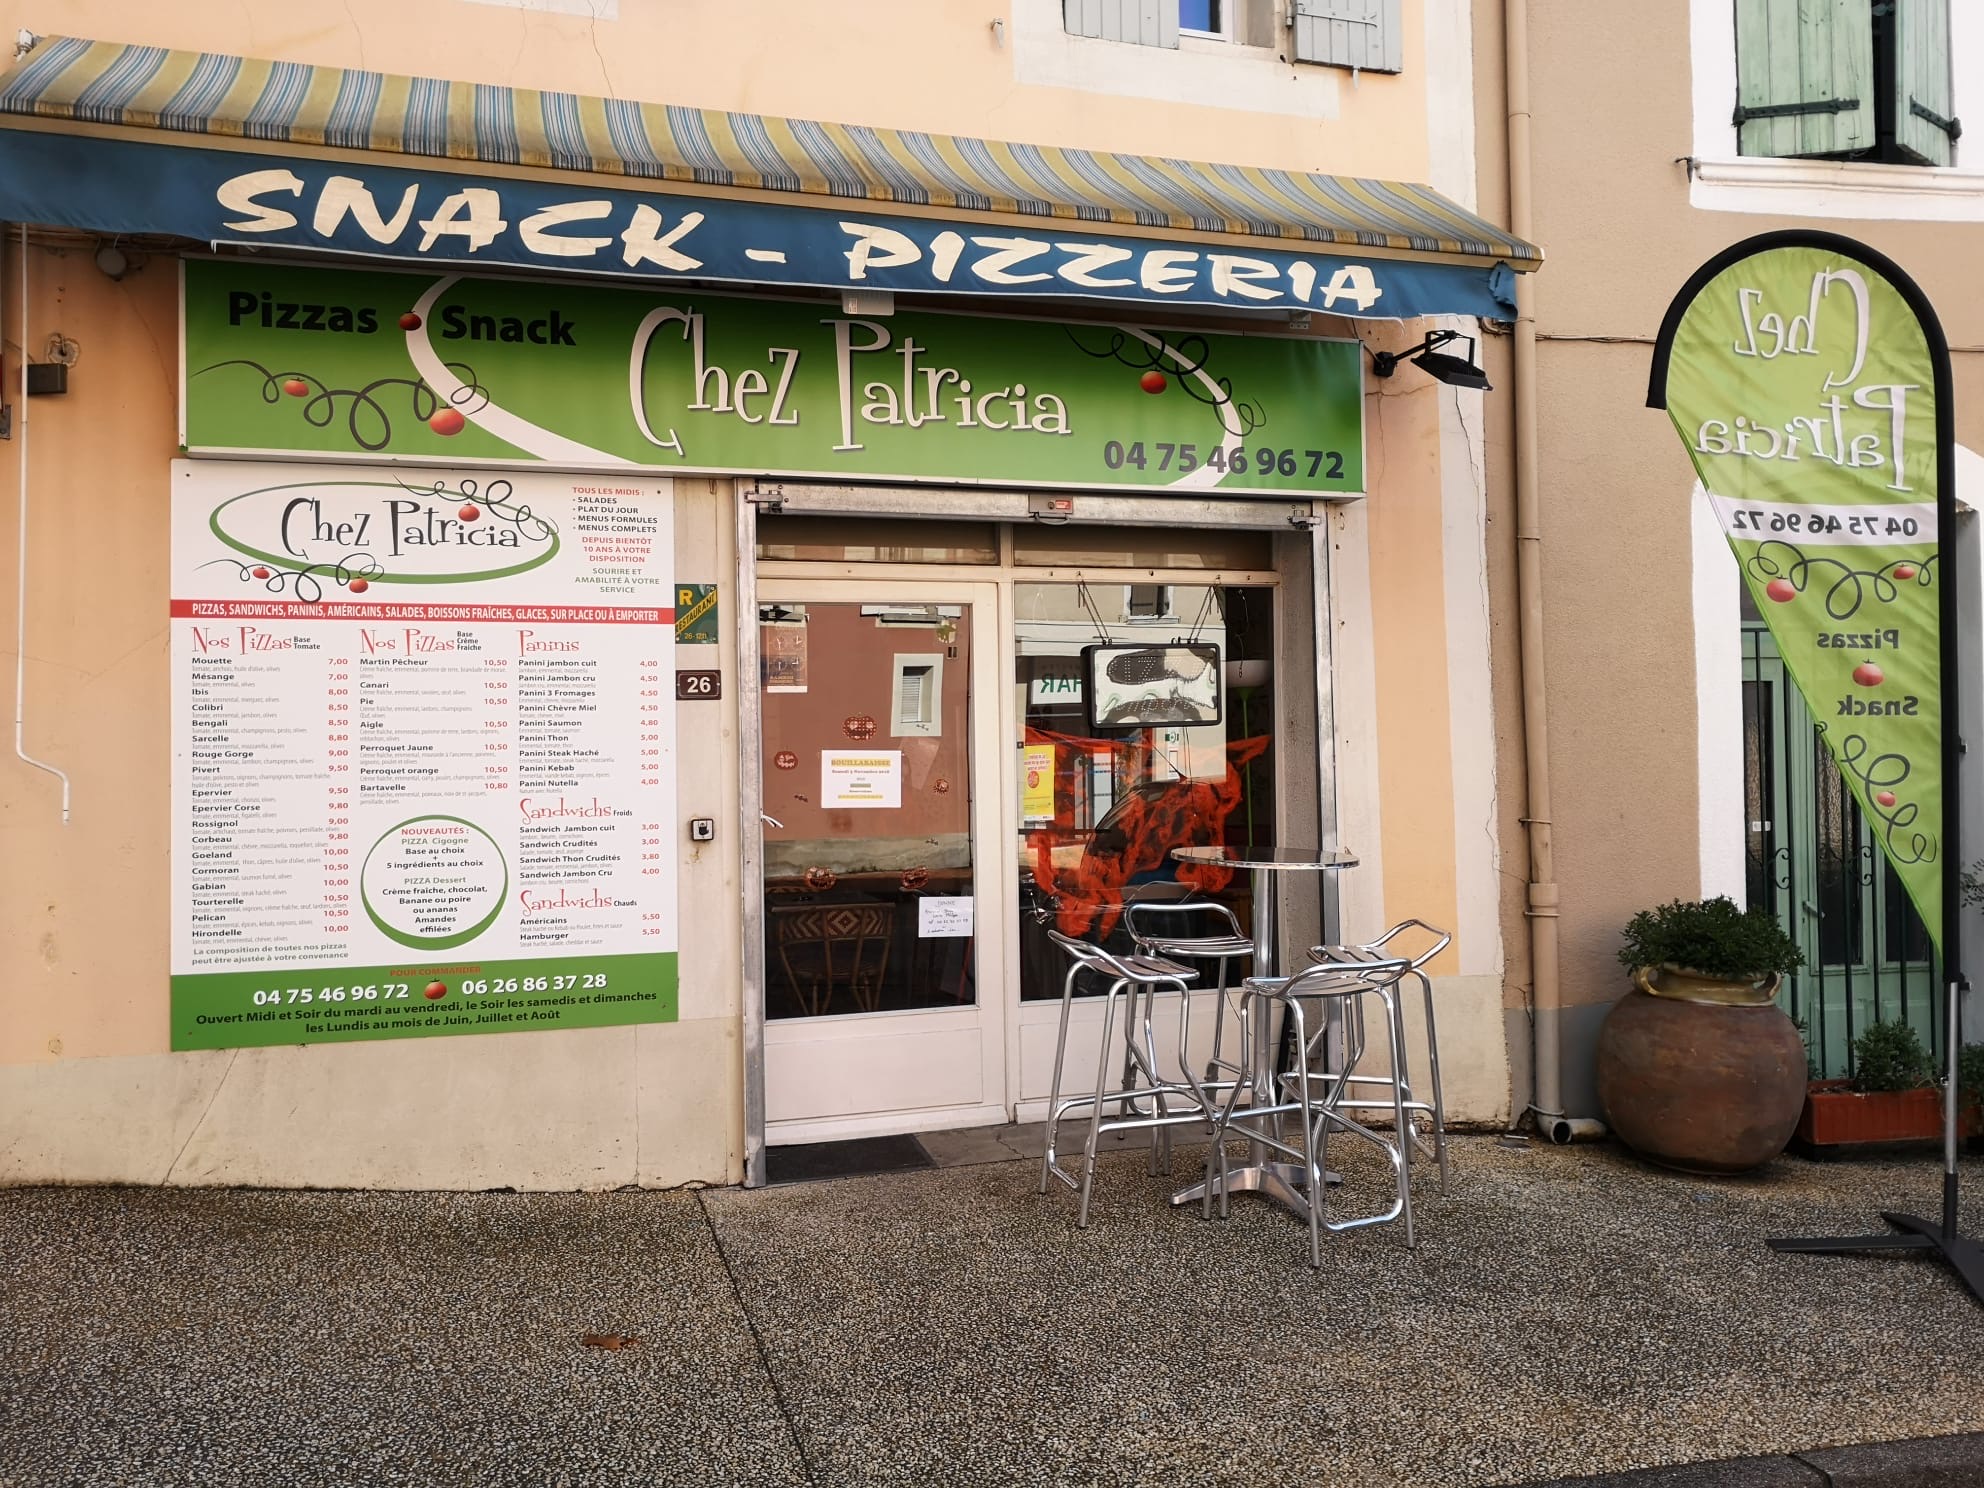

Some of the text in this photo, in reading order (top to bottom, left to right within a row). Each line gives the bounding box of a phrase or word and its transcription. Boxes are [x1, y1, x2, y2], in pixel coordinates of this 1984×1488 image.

[216, 168, 704, 271] SNACK
[839, 221, 1383, 311] PIZZERIA
[229, 291, 378, 334] Pizzas
[442, 305, 577, 346] Snack
[629, 305, 1072, 455] Chez Patricia
[1104, 440, 1345, 479] 04 75 46 96 72
[615, 488, 640, 496] MIDIS
[611, 516, 658, 524] FORMULES
[281, 497, 520, 560] Chez Patricia
[578, 524, 657, 533] MENUS COMPLETS
[615, 536, 653, 545] BIENTÔT
[615, 545, 621, 553] À
[589, 555, 645, 563] DISPOSITION
[575, 576, 621, 584] AMABILITÉ
[679, 589, 693, 606] R
[192, 603, 658, 621] PIZZAS, SANDWICHS, PANINIS, AMÉRICAINS, SALADES, BOISSONS FRAÎCHES, GLACES, SUR PLACE OU À EMPORTER
[191, 626, 292, 655] Nos Pizzas
[359, 628, 455, 657] Nos Pizzas
[516, 629, 580, 658] Paninis
[328, 658, 348, 666] 7,00
[359, 658, 428, 666] Martin Pêcheur
[484, 659, 507, 667] 10,50
[518, 659, 546, 667] Panini
[581, 659, 597, 667] cuit
[192, 673, 235, 681] Mésange
[328, 673, 348, 681] 7,00
[687, 677, 711, 693] 26
[328, 688, 348, 696] 8,00
[192, 703, 224, 711] Colibri
[192, 719, 228, 728] Bengali
[519, 797, 612, 825] Sandwichs
[401, 826, 464, 836] NOUVEAUTÉS
[432, 837, 469, 846] Cigogne
[520, 888, 637, 917] Sandwichs Chauds
[642, 913, 660, 921] 5,50
[520, 932, 569, 941] Hamburger
[642, 928, 661, 936] 5,50
[390, 966, 482, 977] POUR COMMANDER
[461, 973, 607, 995] 06 26 86 37 28
[253, 983, 409, 1006] 04 75 46 96 72
[196, 991, 657, 1025] Ouvert Midi et Soir du mardi au vendredi, le Soir les samedis et dimanches
[305, 1009, 561, 1033] les Lundis au mois de Juin, Juillet et Août
